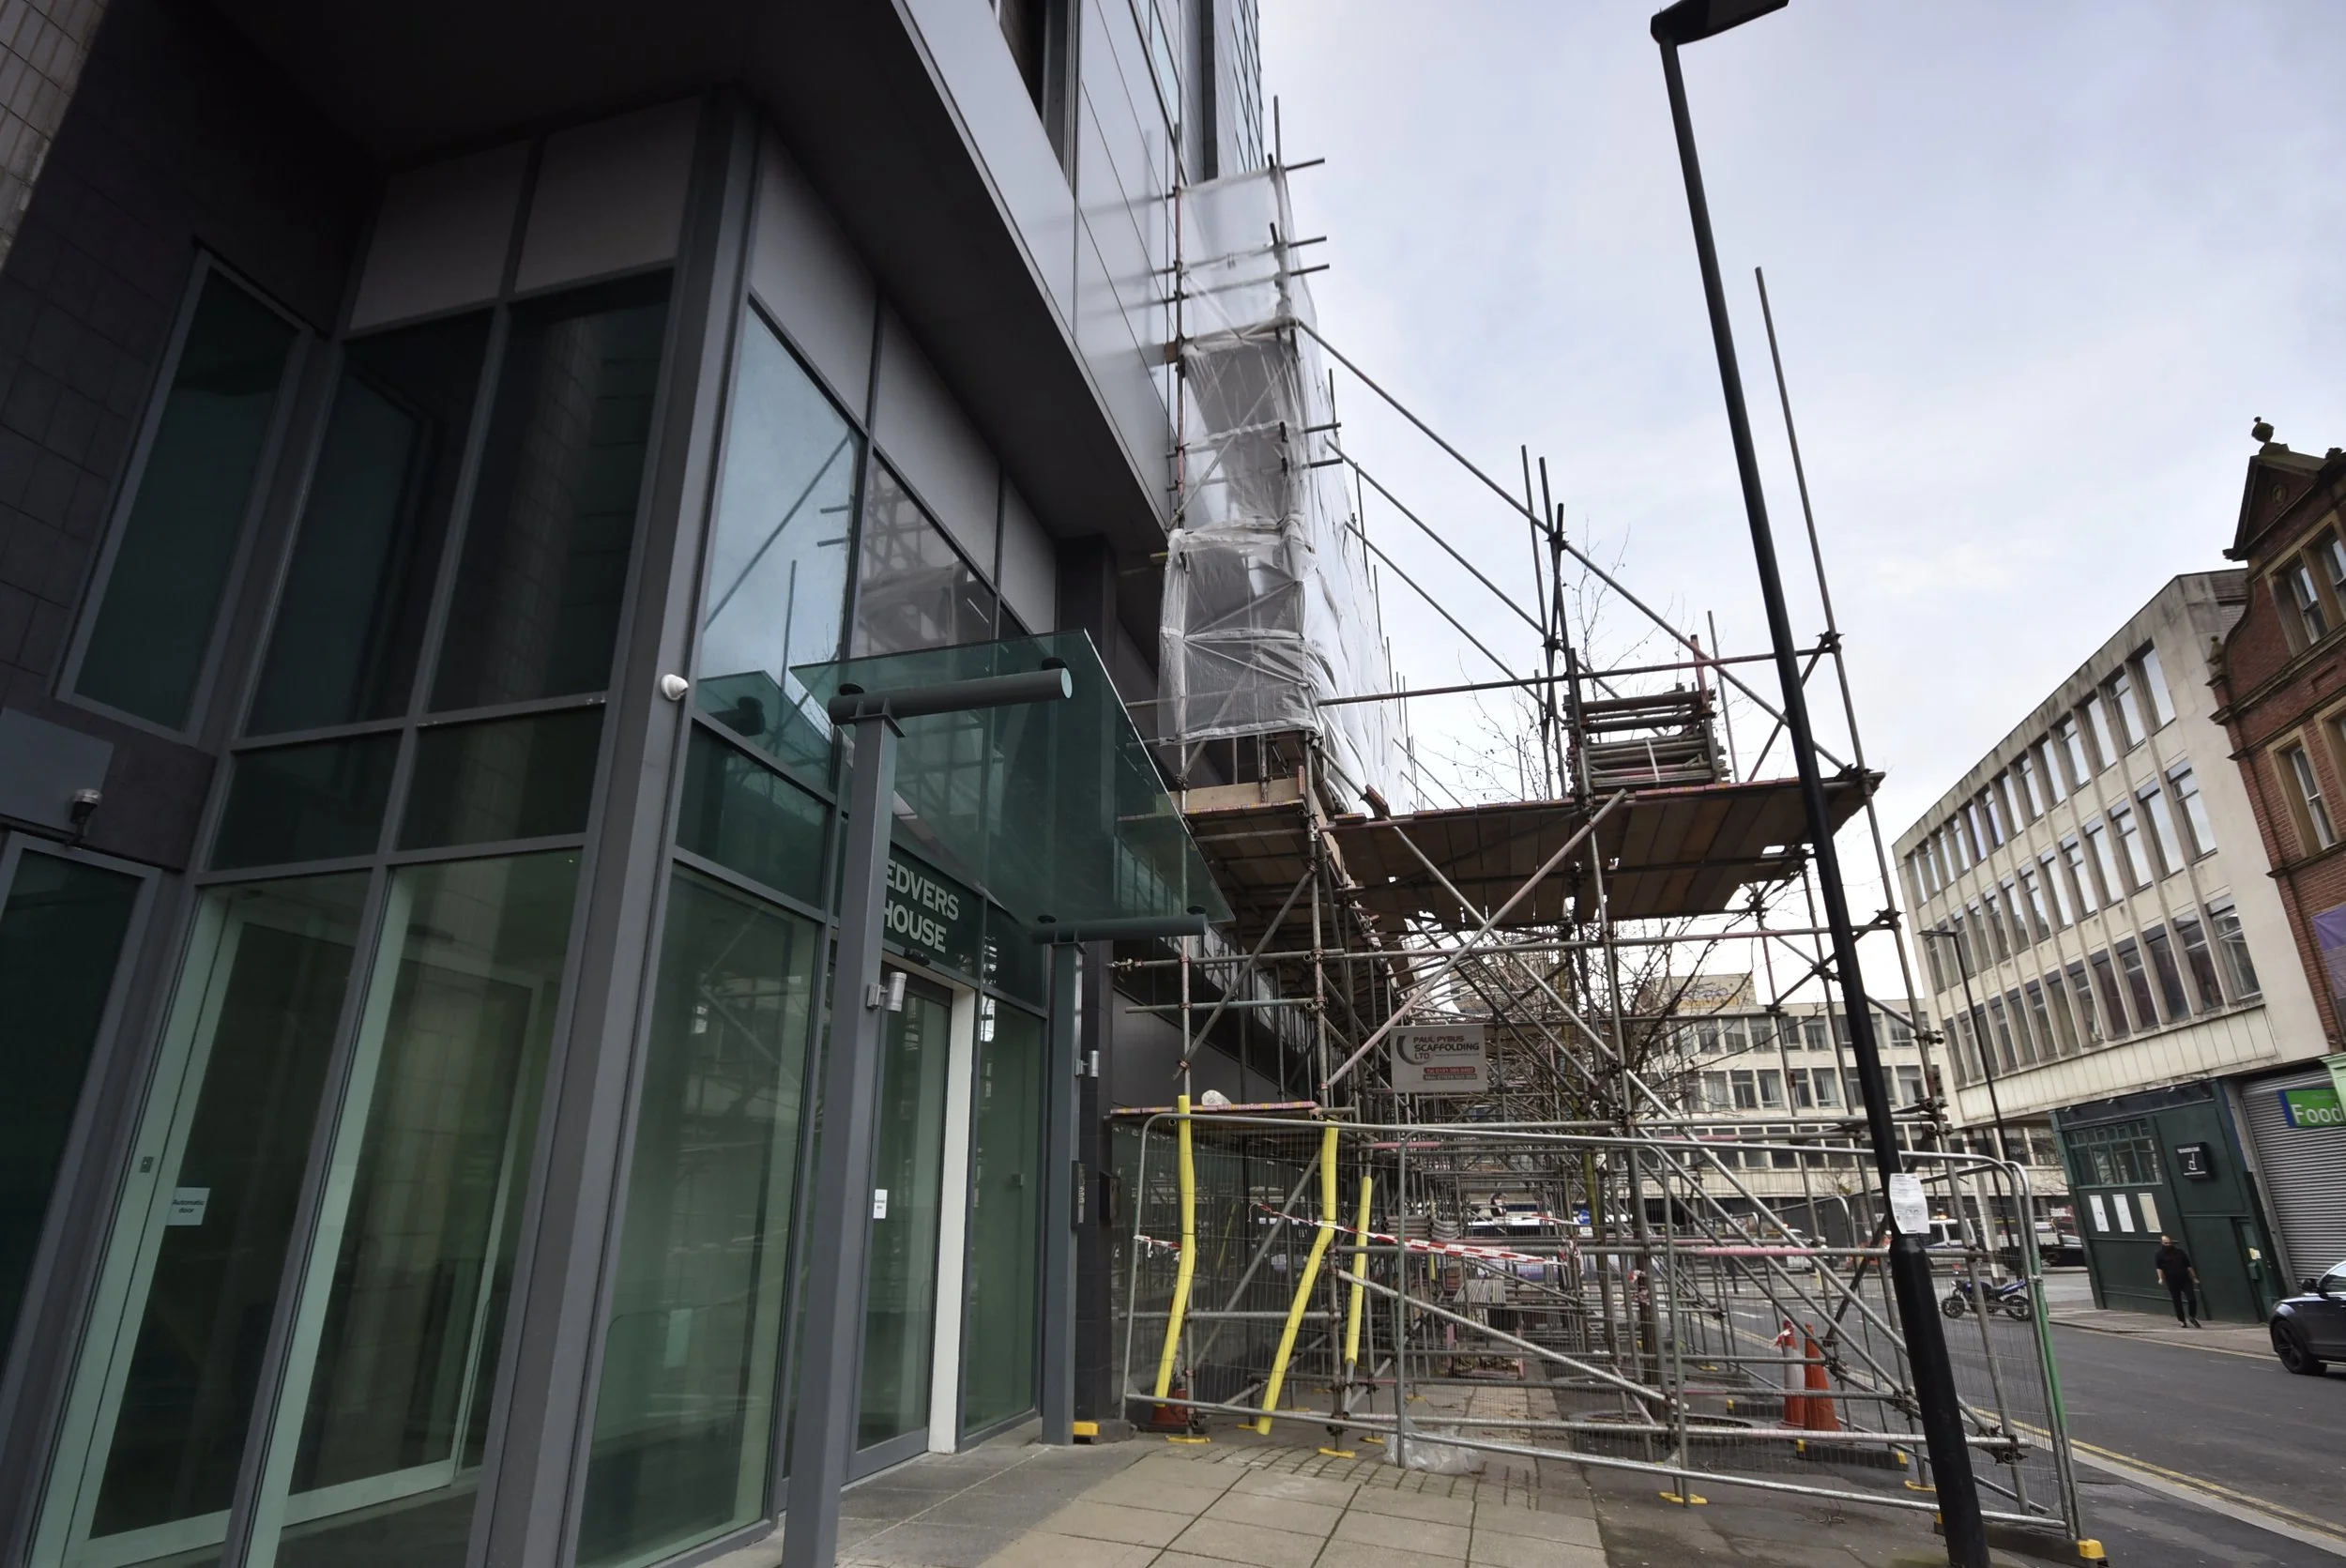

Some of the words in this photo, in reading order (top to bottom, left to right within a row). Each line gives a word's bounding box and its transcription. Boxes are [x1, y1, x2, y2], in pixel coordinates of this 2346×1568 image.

[1414, 1043, 1480, 1053] SCAFFOLDING
[1414, 1052, 1430, 1060] LTD
[2290, 1102, 2345, 1124] Food
